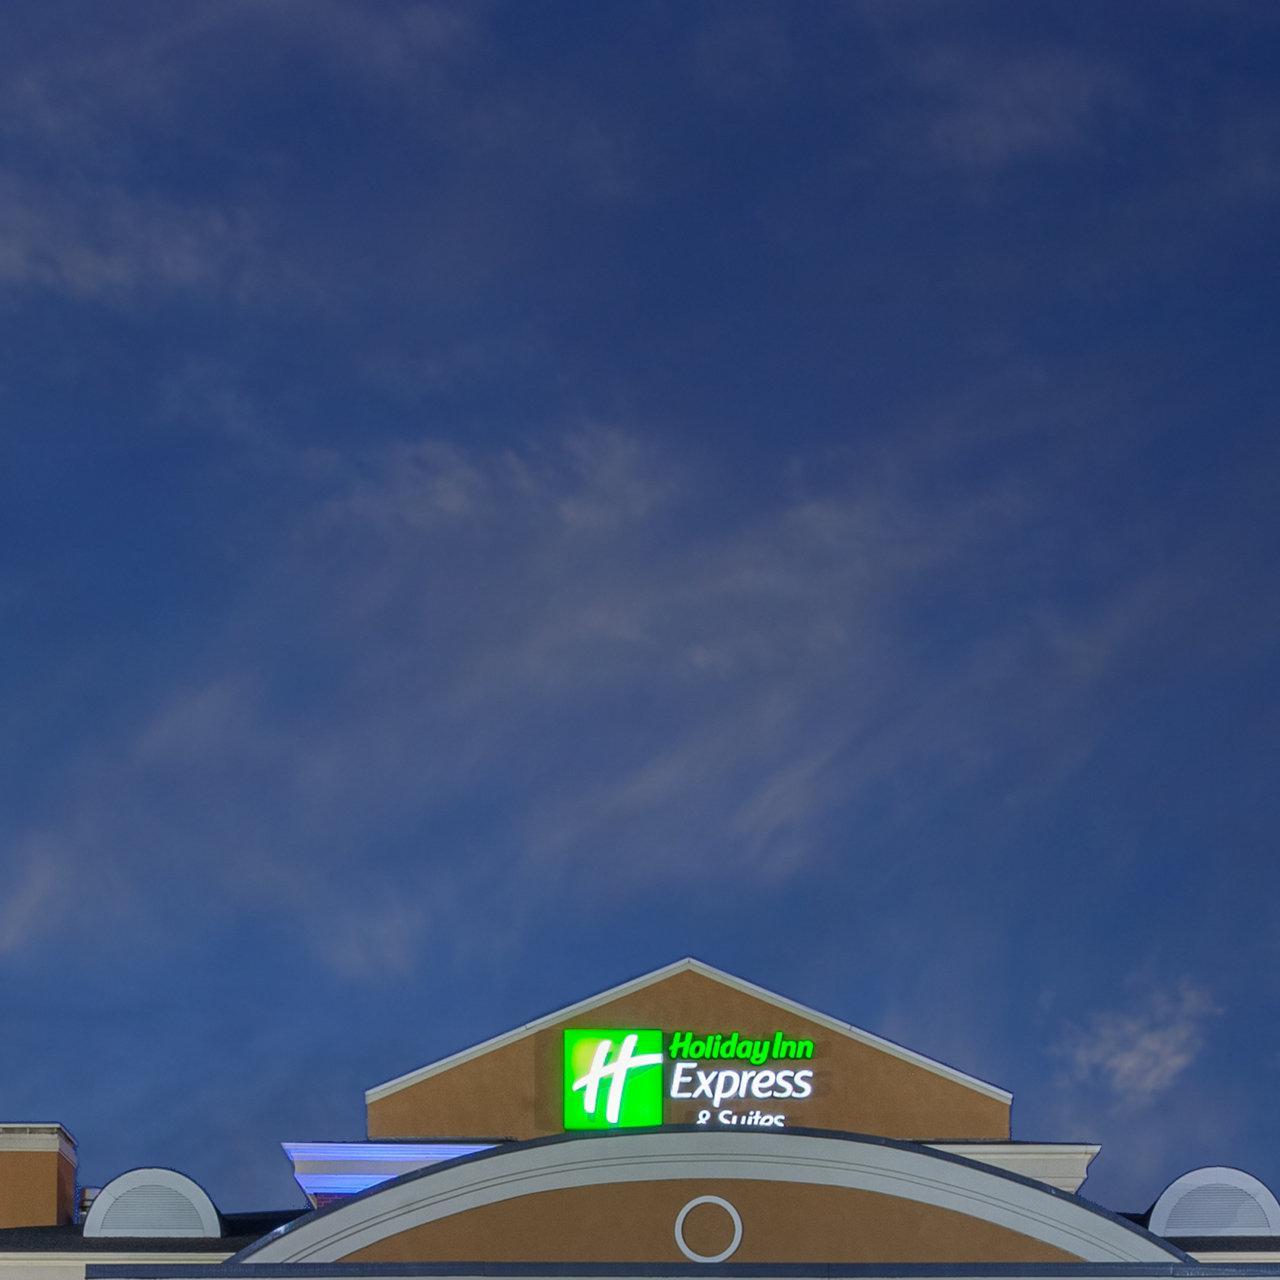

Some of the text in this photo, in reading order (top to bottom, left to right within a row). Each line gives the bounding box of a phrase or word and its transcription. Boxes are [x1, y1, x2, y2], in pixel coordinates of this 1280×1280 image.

[669, 1031, 815, 1065] Holiday Inn
[670, 1062, 814, 1108] Express
